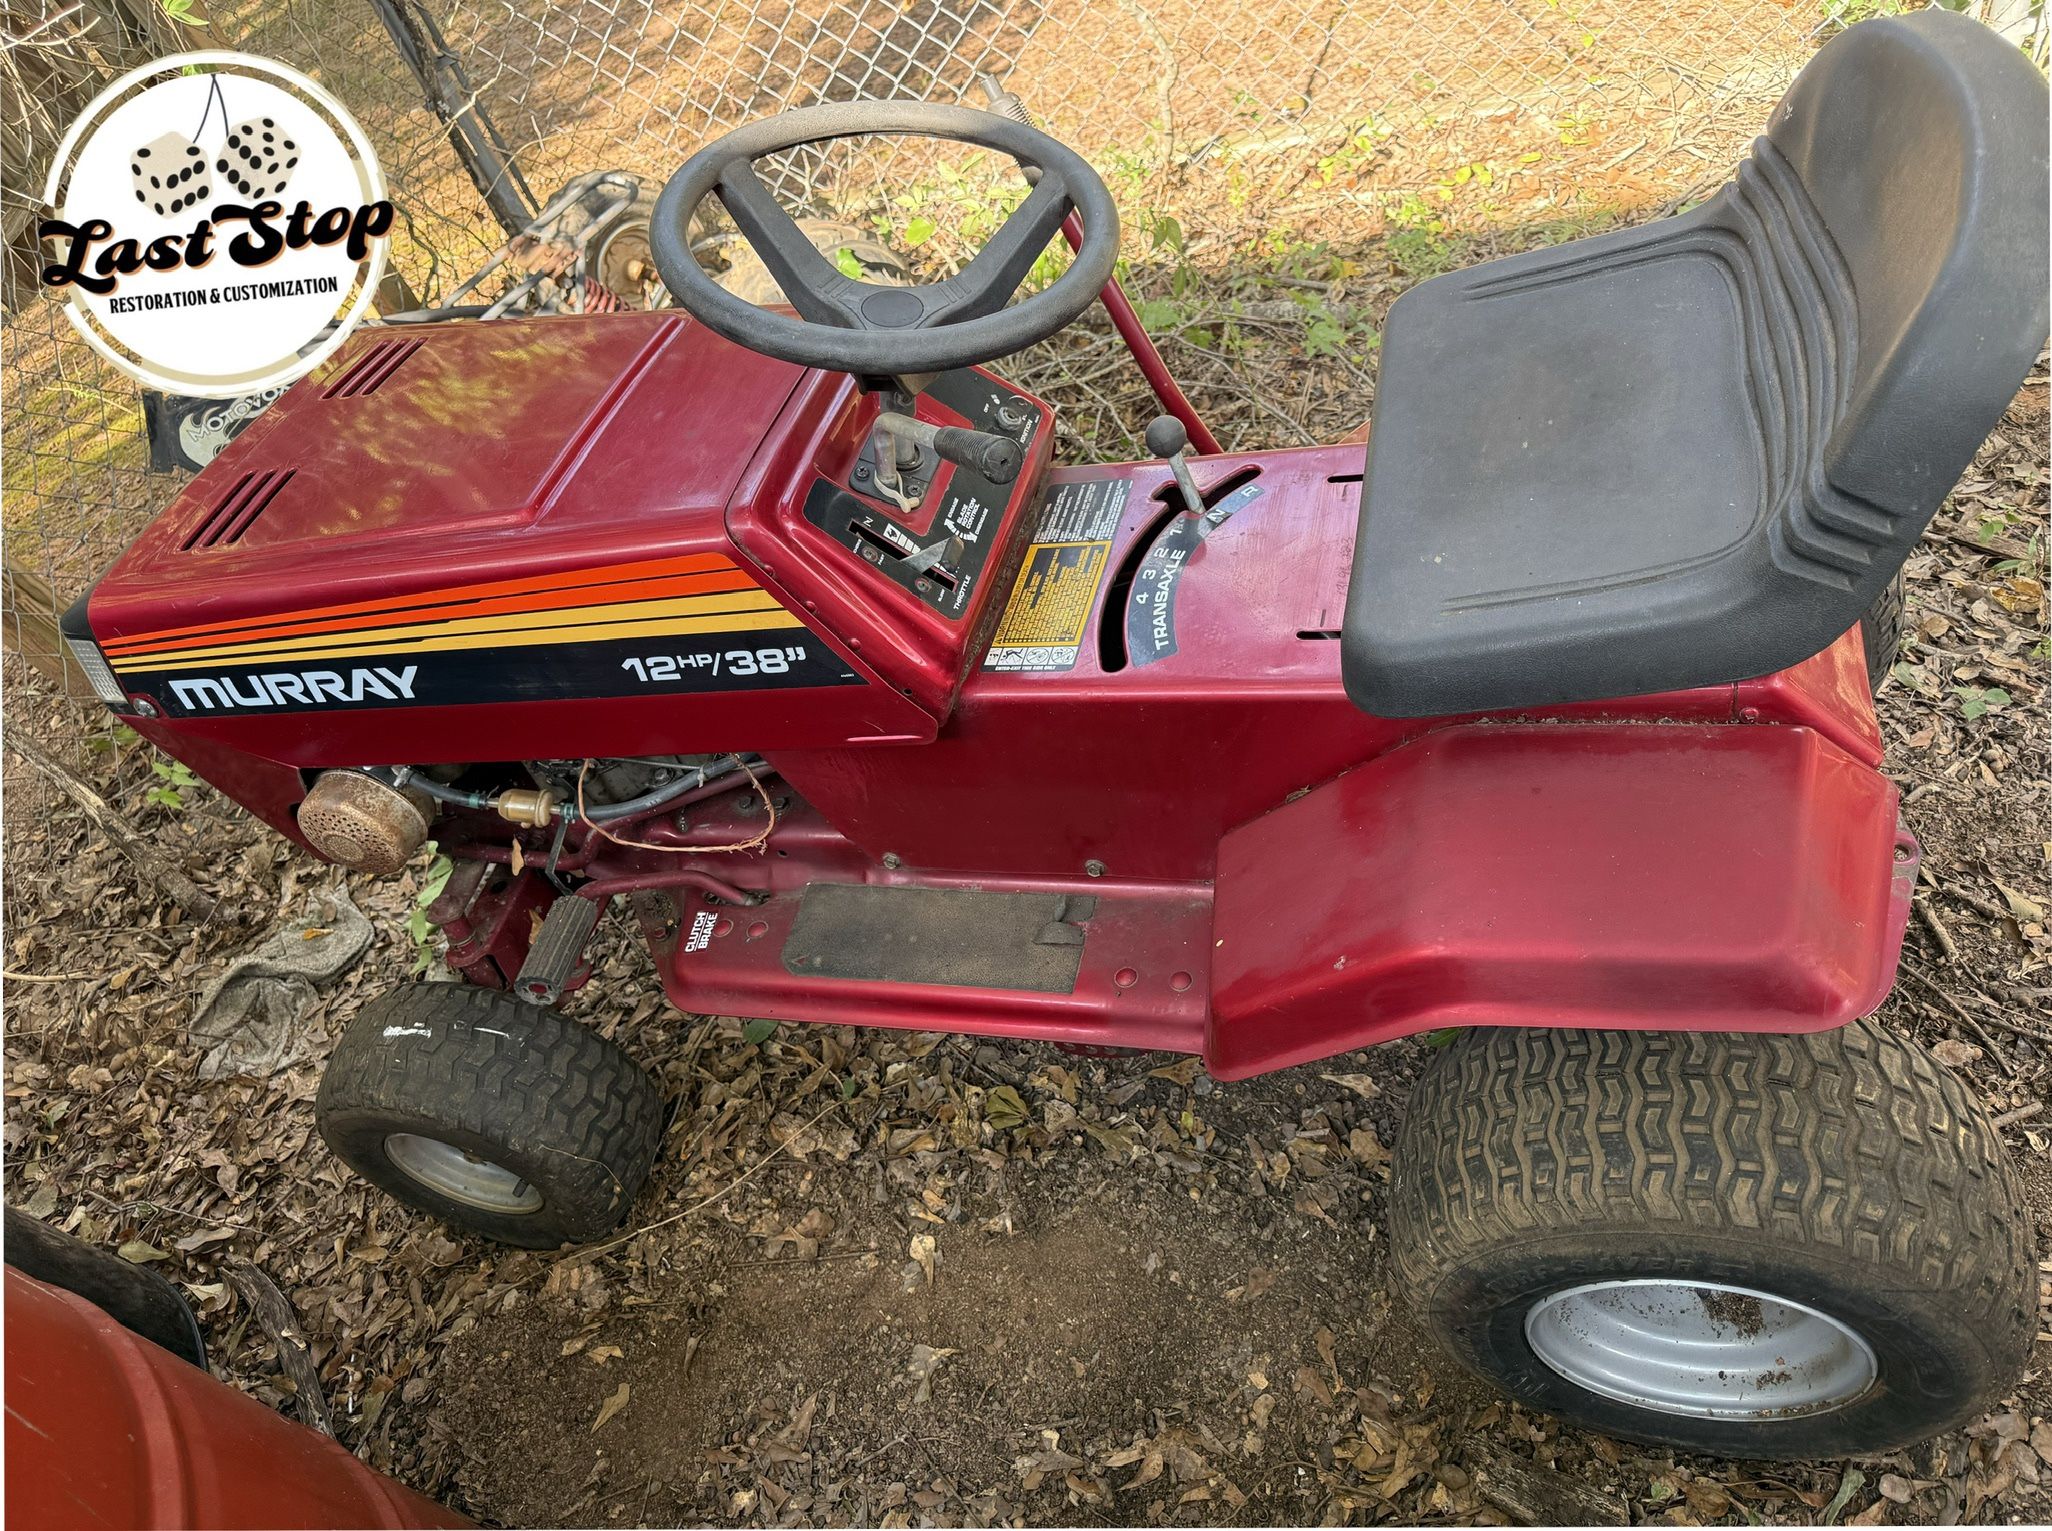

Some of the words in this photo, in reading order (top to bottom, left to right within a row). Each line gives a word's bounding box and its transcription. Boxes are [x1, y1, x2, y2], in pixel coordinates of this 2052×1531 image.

[1240, 485, 1259, 497] R
[956, 503, 968, 524] BLADE
[961, 497, 977, 527] ROTATION
[965, 503, 980, 530] CONTROL
[1206, 508, 1226, 524] N
[1154, 547, 1169, 559] 2
[1142, 568, 1156, 580] 3
[952, 575, 972, 610] THROTTLE
[1135, 591, 1149, 605] 4
[1153, 549, 1186, 650] TRANSAXLE
[167, 664, 419, 711] MURRAY
[685, 912, 706, 952] CLUTCH
[698, 912, 718, 949] BRAKE
